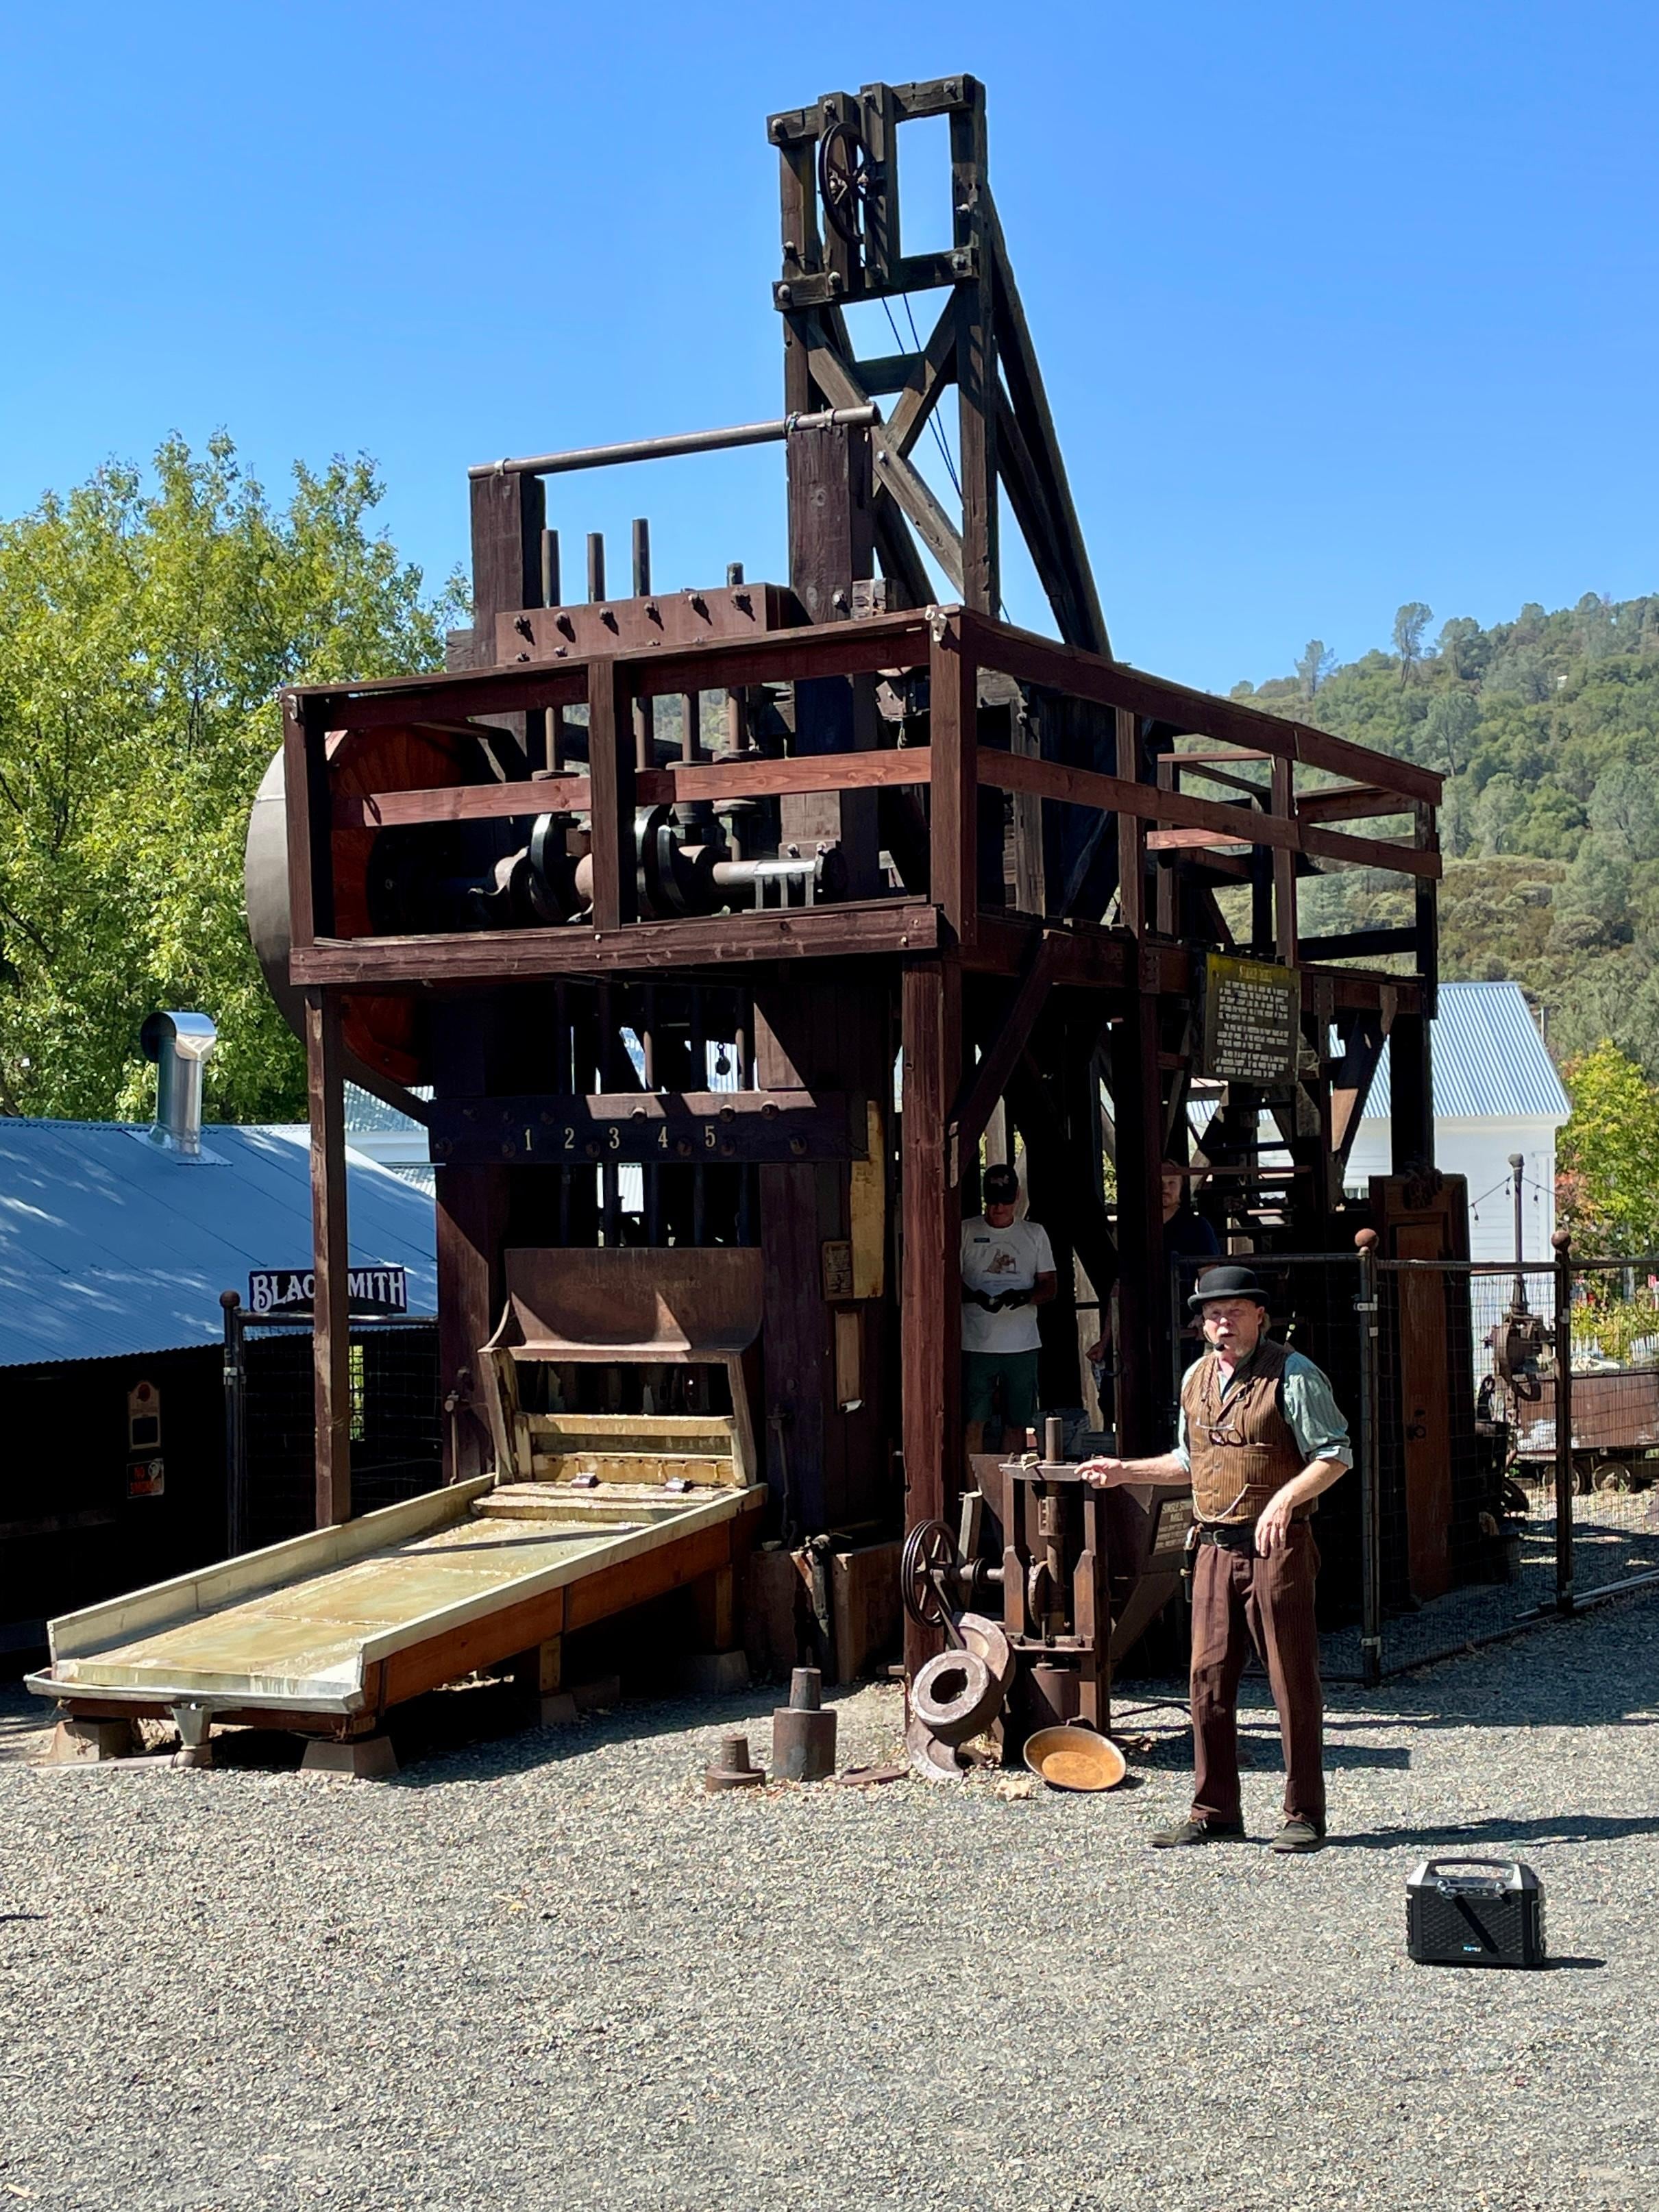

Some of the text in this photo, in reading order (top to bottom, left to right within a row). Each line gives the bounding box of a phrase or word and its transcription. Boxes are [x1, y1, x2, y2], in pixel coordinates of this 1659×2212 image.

[525, 1125, 716, 1151] 1 2 3 4 5
[252, 1271, 406, 1313] BLACMITH
